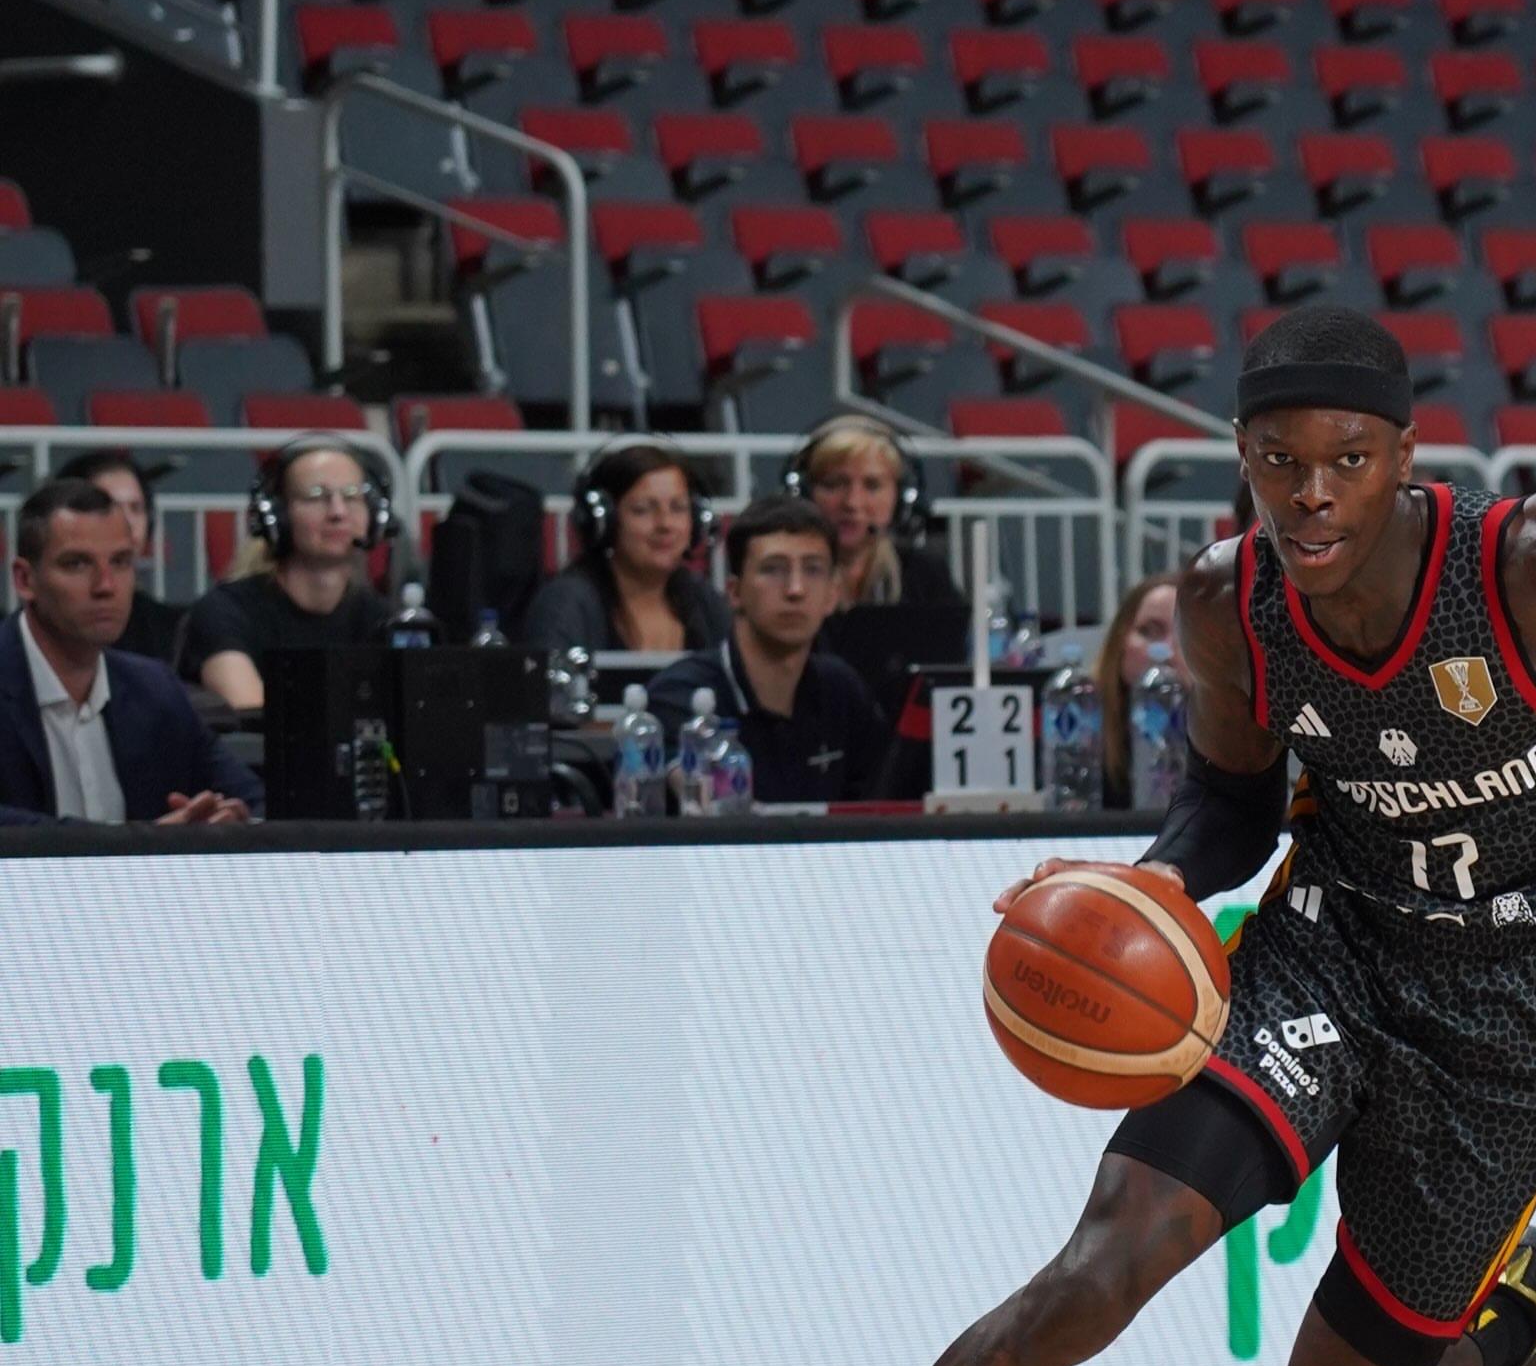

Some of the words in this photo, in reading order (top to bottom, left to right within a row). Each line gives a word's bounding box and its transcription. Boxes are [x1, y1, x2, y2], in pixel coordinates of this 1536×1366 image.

[951, 695, 976, 735] 2
[1002, 695, 1021, 733] 2
[954, 746, 968, 787] 1
[1005, 746, 1017, 785] 1
[1400, 832, 1479, 900] 17
[1013, 959, 1112, 1025] molten
[1253, 1027, 1320, 1096] Domino's
[1259, 1053, 1298, 1098] Pizza
